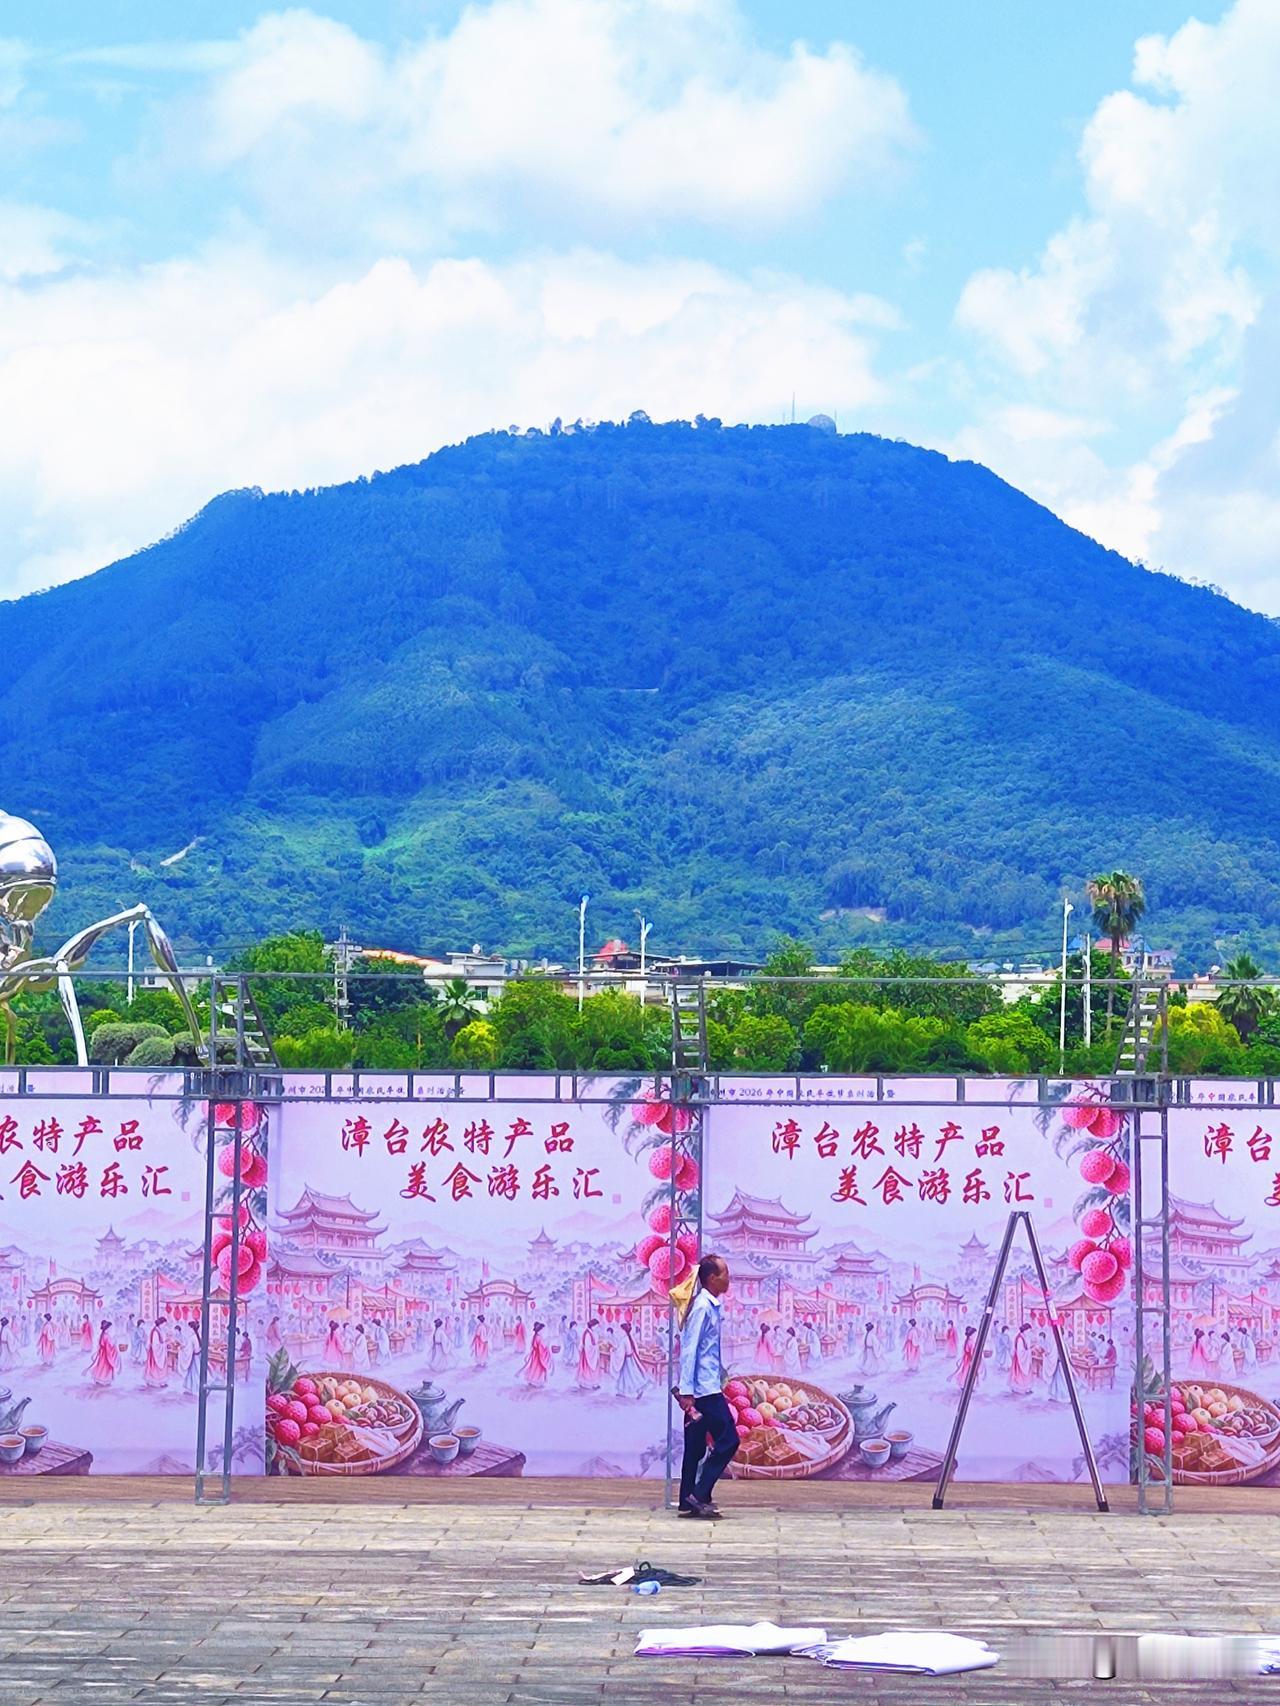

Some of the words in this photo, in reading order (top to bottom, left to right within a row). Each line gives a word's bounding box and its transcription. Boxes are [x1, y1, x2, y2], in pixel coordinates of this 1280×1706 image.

[0, 1115, 145, 1157] 农特产品
[341, 1115, 574, 1159] 漳台农特产品
[771, 1119, 1007, 1163] 漳台农特产品
[1203, 1122, 1273, 1165] 漳台
[0, 1159, 172, 1200] 食游乐汇
[398, 1161, 604, 1203] 美食游乐汇
[829, 1165, 1036, 1207] 美食游乐汇
